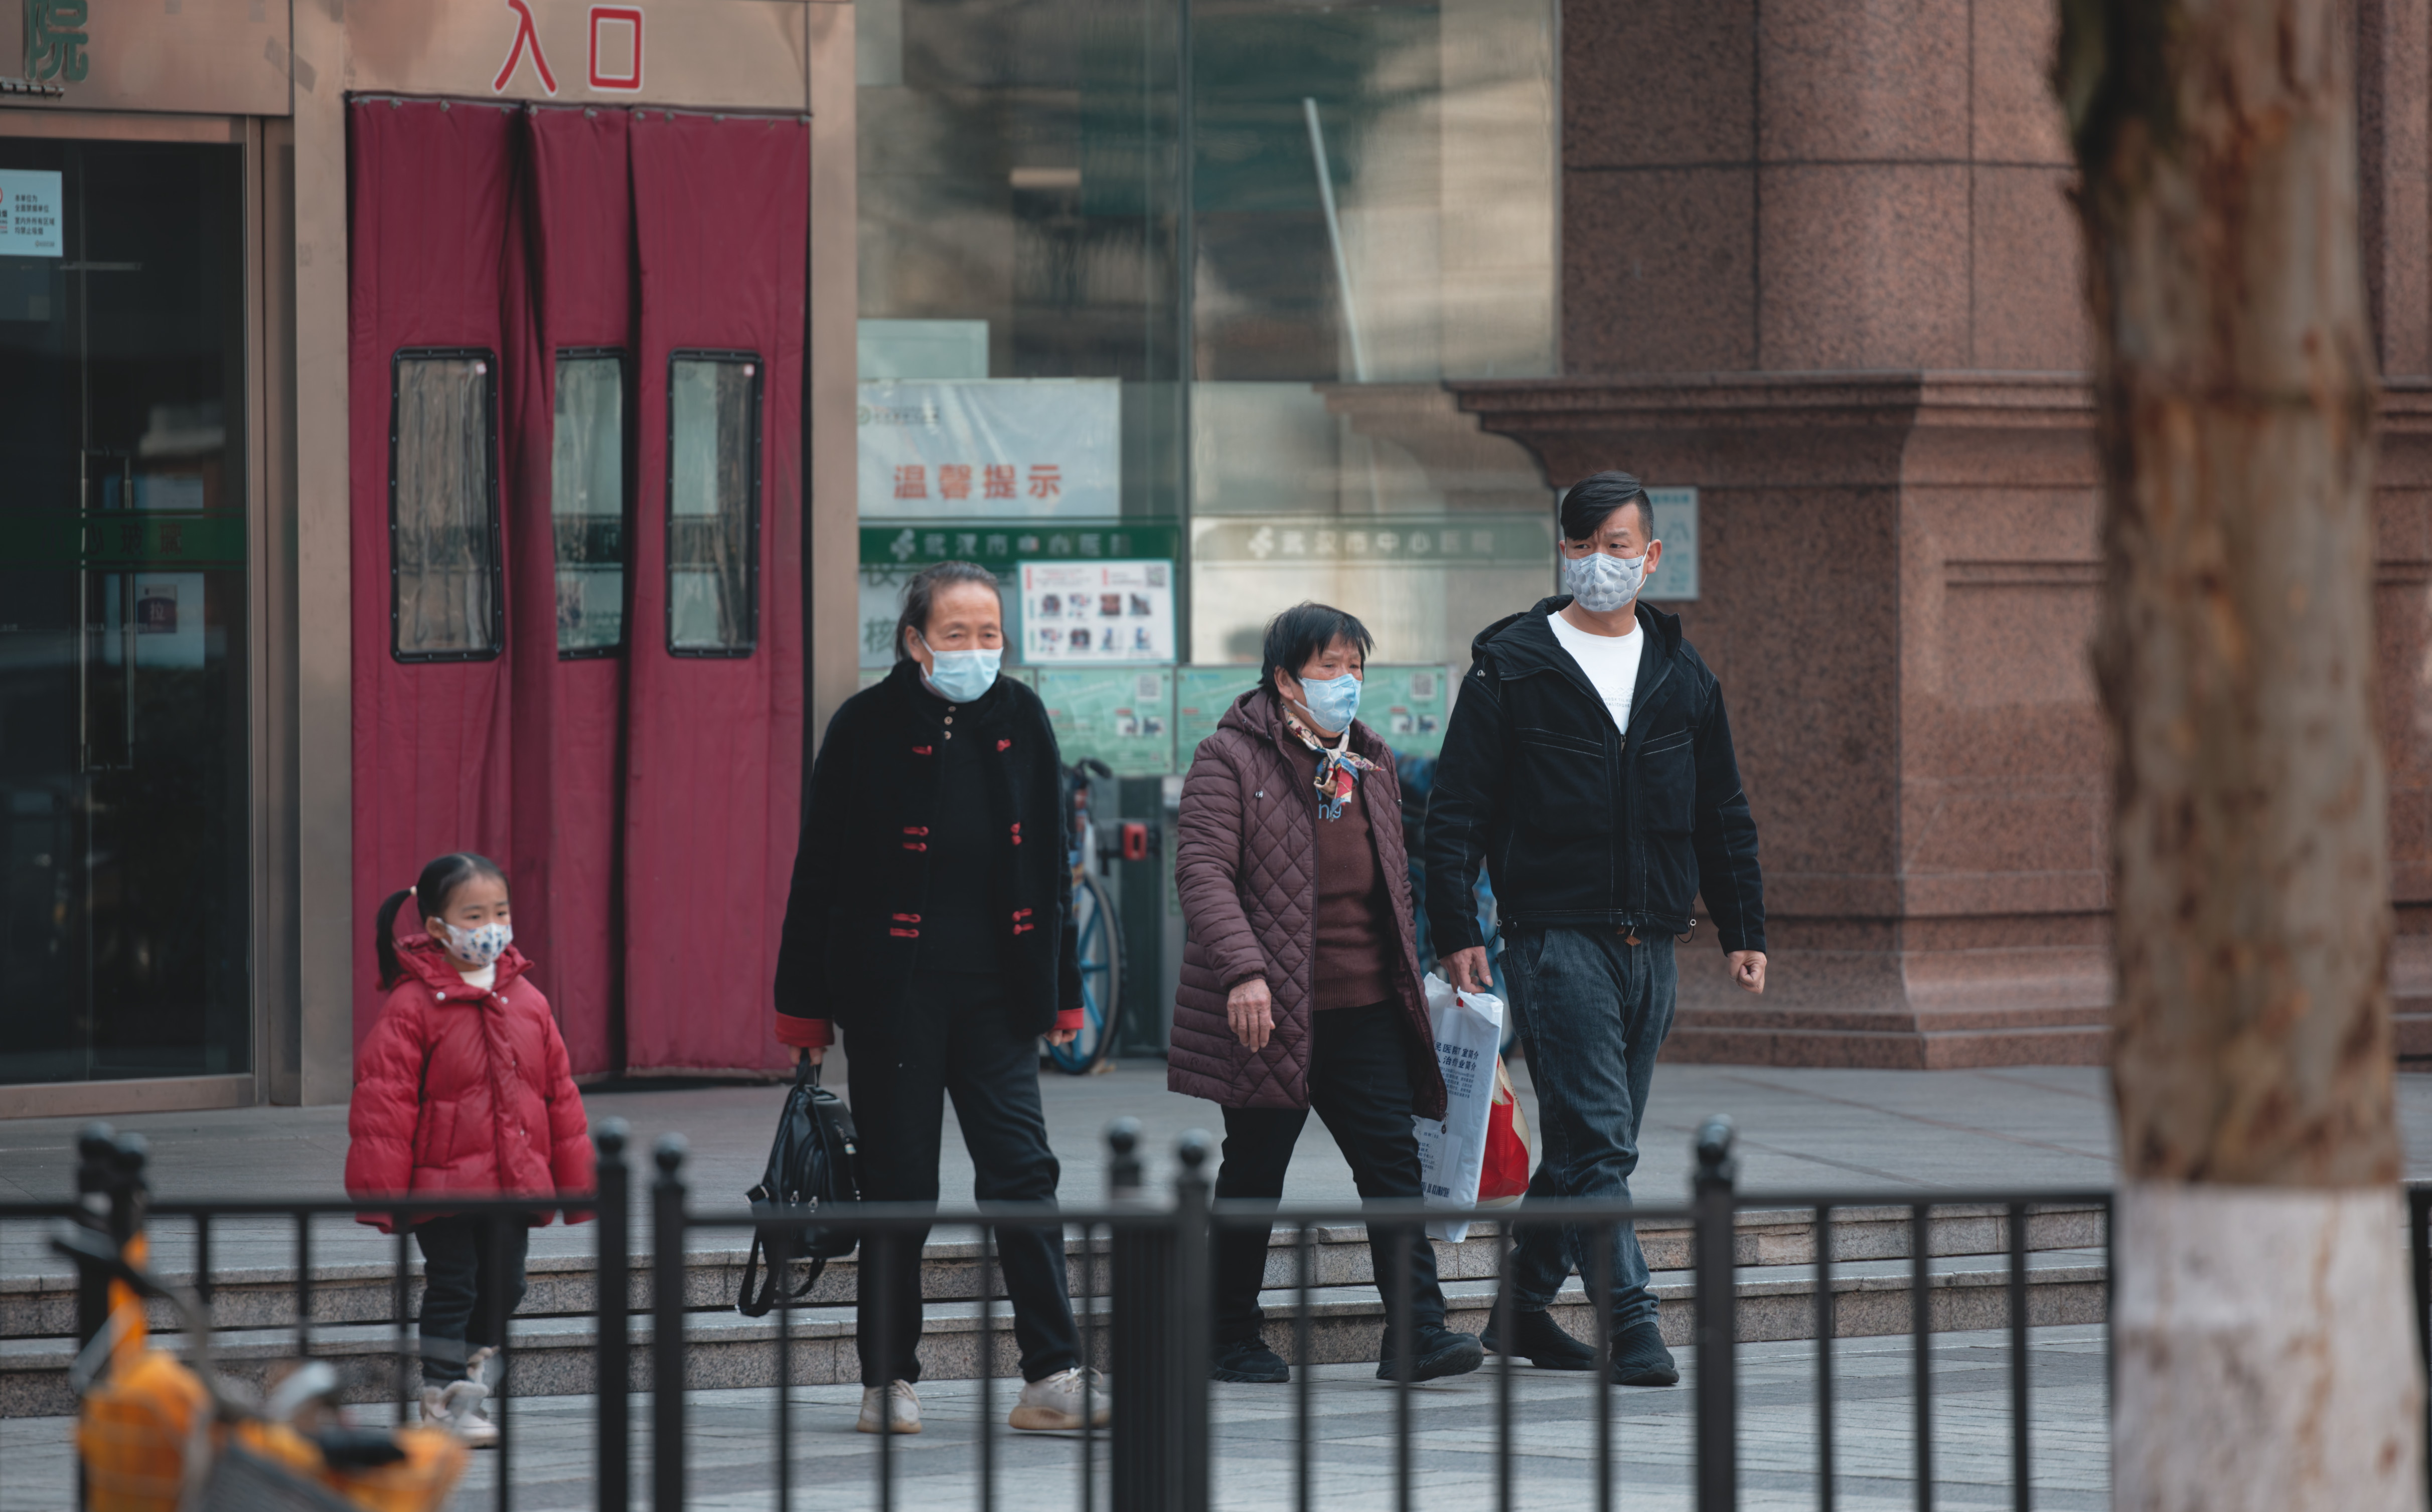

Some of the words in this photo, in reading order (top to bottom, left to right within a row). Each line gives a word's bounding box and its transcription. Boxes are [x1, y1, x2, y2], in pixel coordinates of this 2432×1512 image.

[24, 0, 89, 82] 院
[492, 0, 645, 96] 入口
[892, 463, 1062, 500] 温馨提示
[41, 522, 182, 556] 小心玻璃
